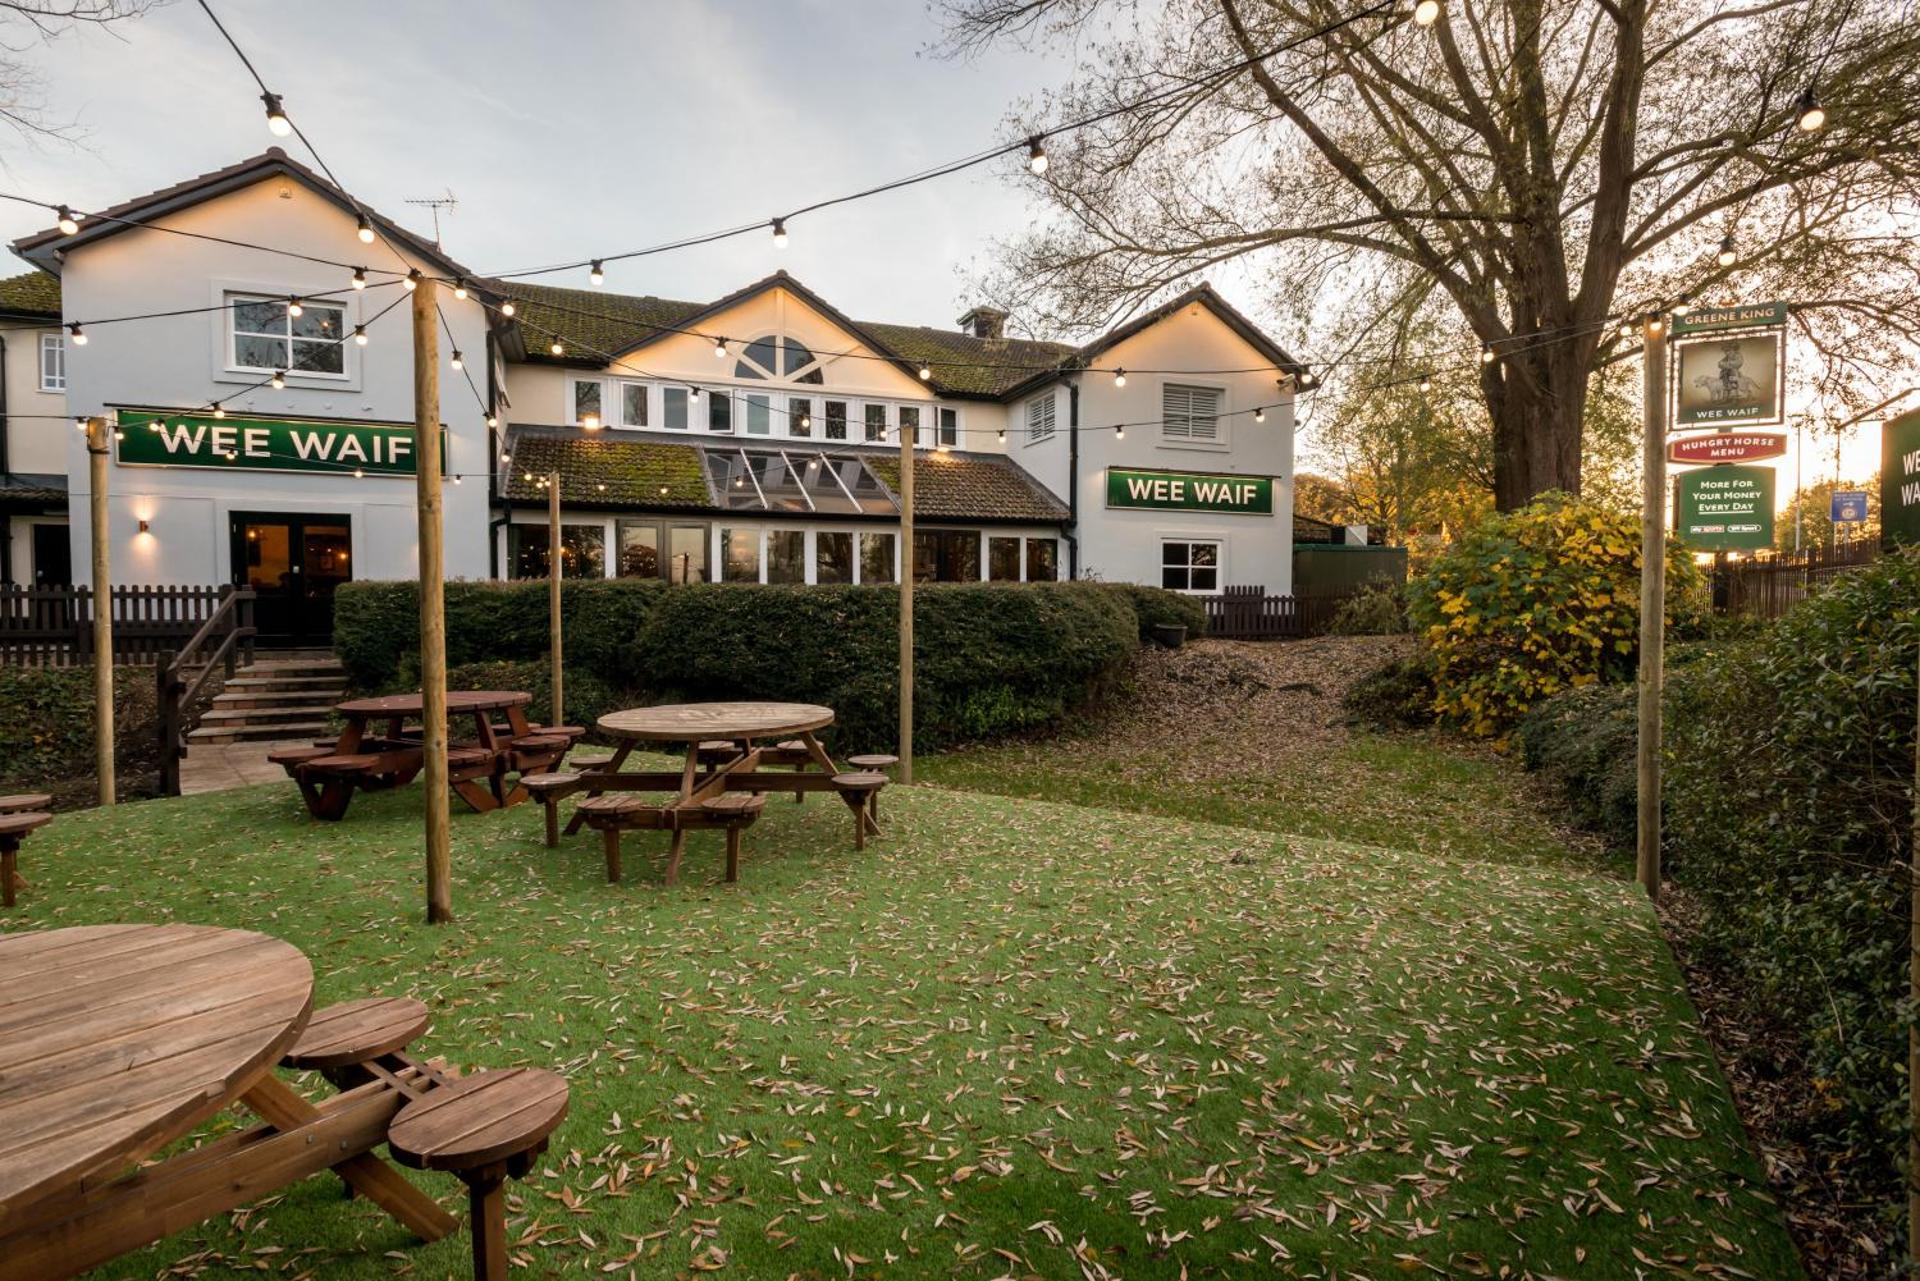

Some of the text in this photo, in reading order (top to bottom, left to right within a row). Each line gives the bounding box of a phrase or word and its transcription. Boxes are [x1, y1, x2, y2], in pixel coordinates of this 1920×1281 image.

[1685, 307, 1775, 325] GREENE KING
[1696, 407, 1759, 418] WEE WAIF
[159, 424, 412, 464] WEE WAIF
[1682, 437, 1775, 451] HUNGRY HORSE
[1710, 448, 1745, 457] MENU
[1127, 478, 1258, 505] WEE WAIF
